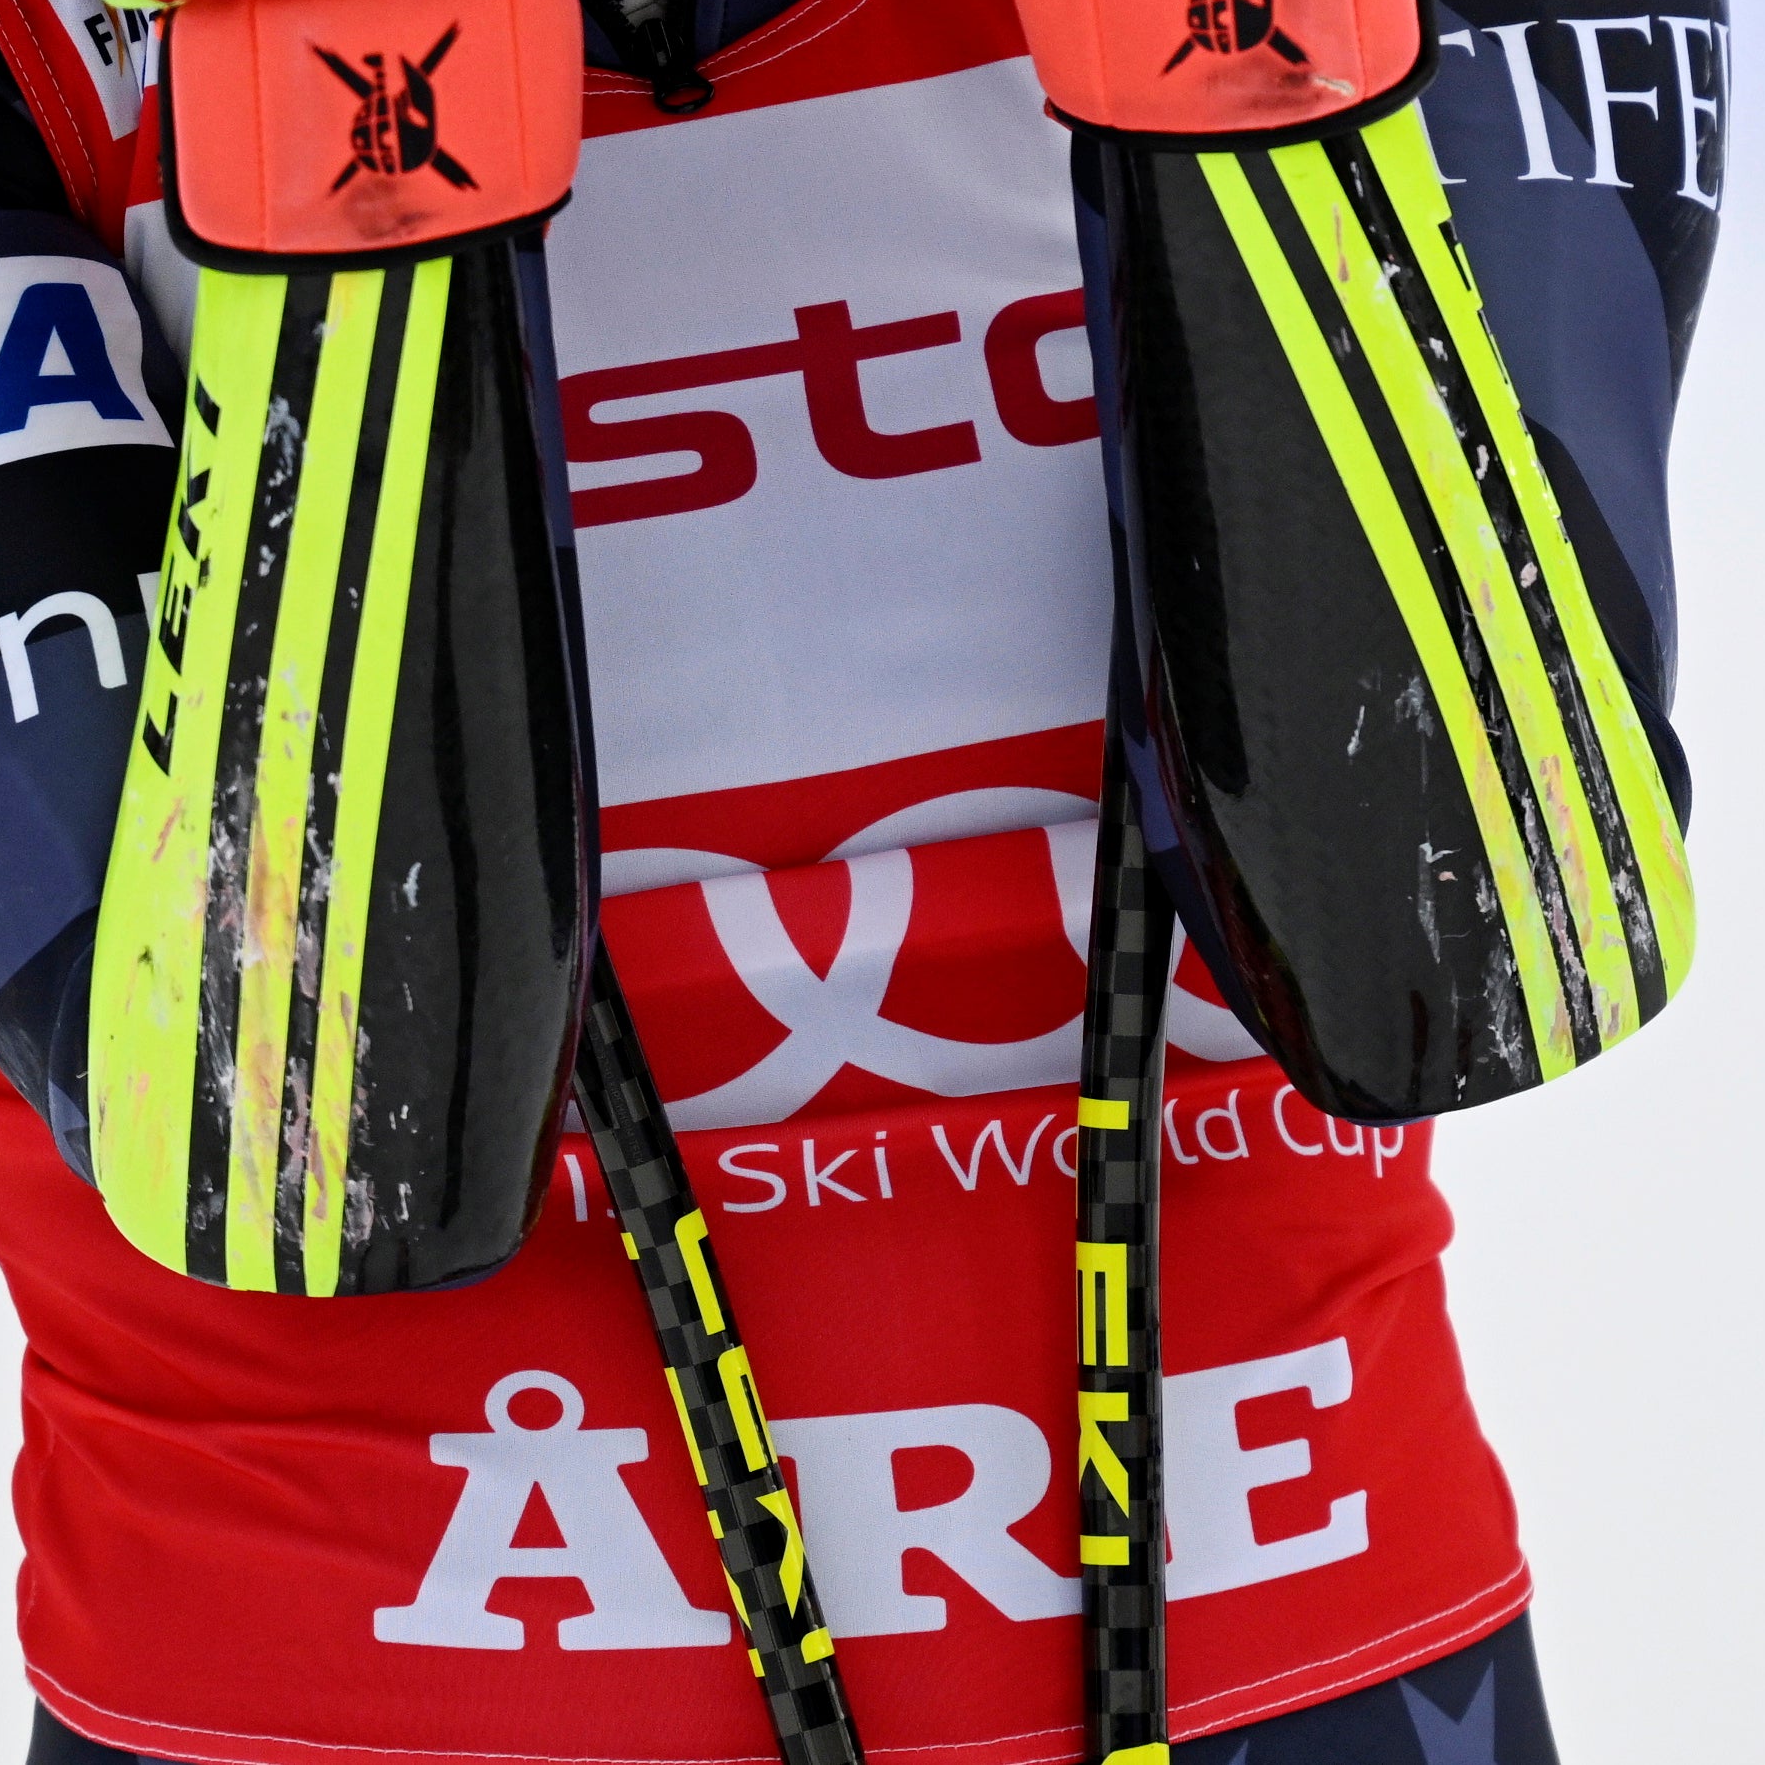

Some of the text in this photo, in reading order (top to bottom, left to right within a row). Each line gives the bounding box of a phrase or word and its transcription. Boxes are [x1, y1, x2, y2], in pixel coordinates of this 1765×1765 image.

[1425, 15, 1730, 211] IFE
[142, 375, 222, 780] LEKI
[717, 1131, 894, 1214] Ski
[931, 1089, 1250, 1192] Wold
[1272, 1083, 1404, 1180] Cup
[373, 1335, 1369, 1652] ÅRE
